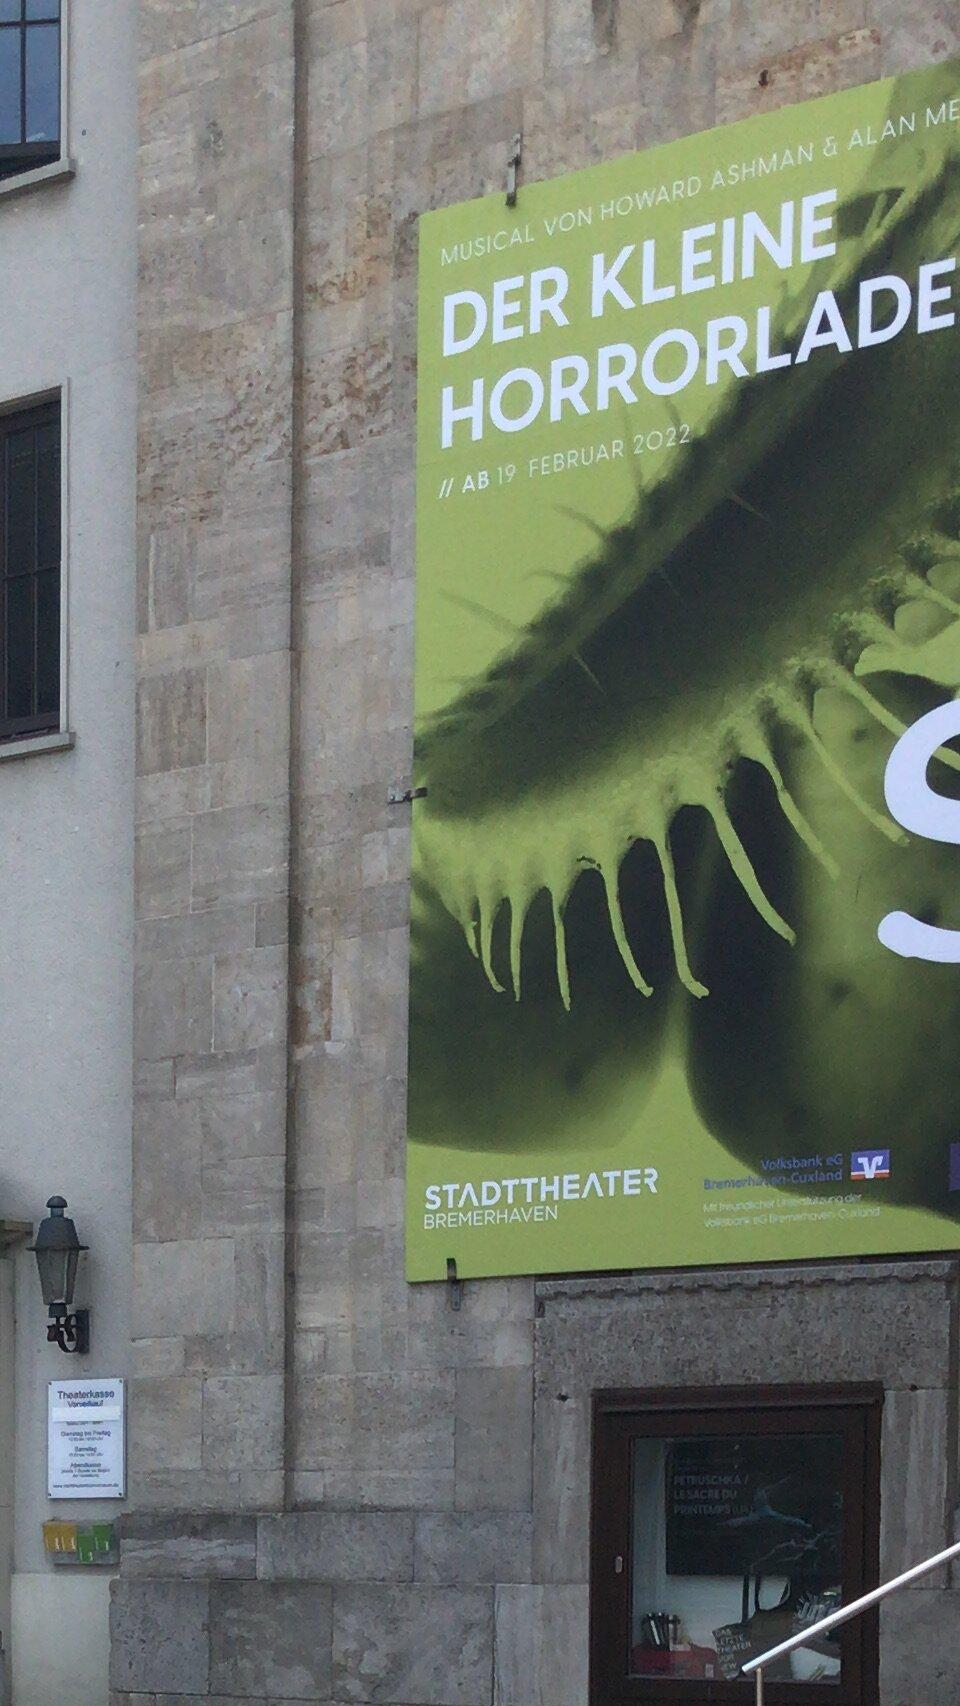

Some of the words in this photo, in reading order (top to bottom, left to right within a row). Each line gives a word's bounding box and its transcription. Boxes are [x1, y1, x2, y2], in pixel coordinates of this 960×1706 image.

[441, 226, 534, 266] MUSICAL
[544, 207, 593, 237] VON
[600, 176, 702, 221] HOWARD
[710, 142, 814, 190] ASHMAN
[823, 136, 838, 157] &
[848, 112, 916, 151] ALAN
[926, 98, 960, 128] ME
[443, 265, 570, 358] DER
[591, 188, 838, 319] KLEINE
[440, 257, 957, 450] HORRORLADE
[462, 470, 490, 494] AB
[497, 463, 517, 486] 19
[528, 438, 625, 479] FEBRUAR
[633, 424, 692, 456] 2022
[424, 1167, 659, 1210] STADTTHEATER
[761, 1155, 823, 1171] Volksbank
[424, 1205, 558, 1230] BREMERHAVEN
